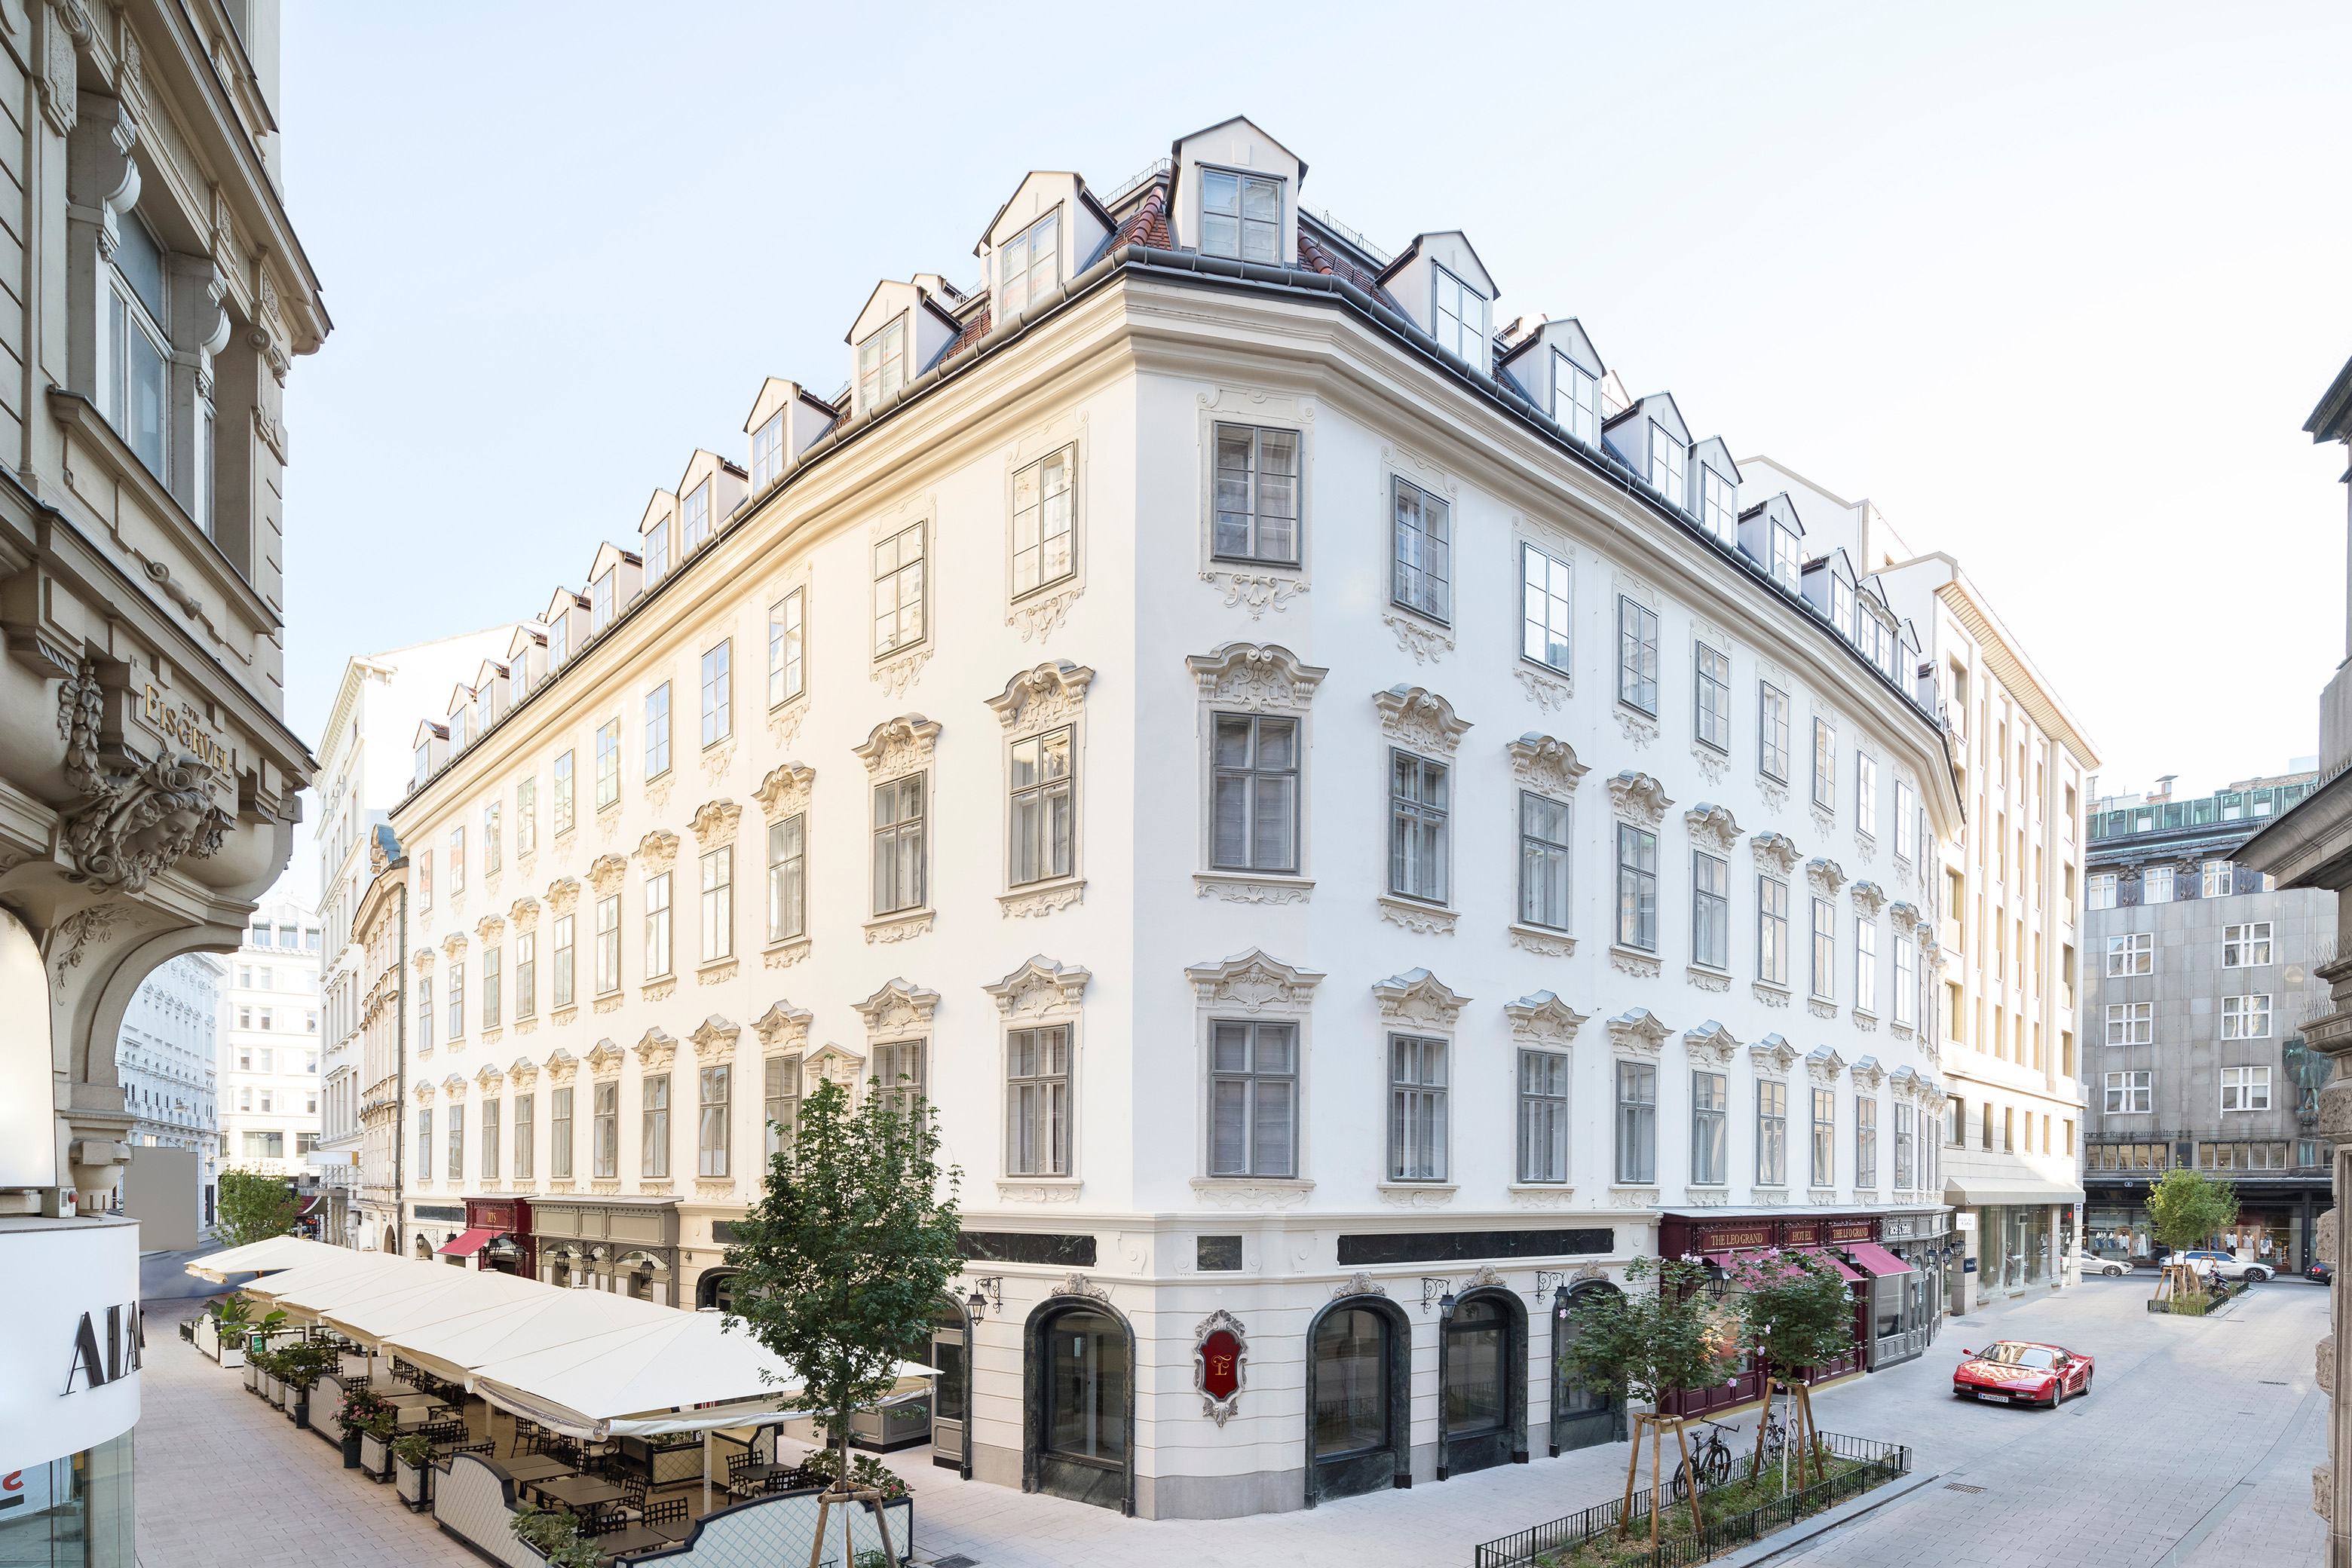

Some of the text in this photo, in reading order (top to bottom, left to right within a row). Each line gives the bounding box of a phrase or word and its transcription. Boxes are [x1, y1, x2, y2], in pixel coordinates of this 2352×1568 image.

[1792, 1230, 1813, 1242] HOTEL
[1833, 1229, 1843, 1239] THE
[1853, 1227, 1869, 1237] GRAND
[1710, 1233, 1763, 1246] THE LEO GRAND
